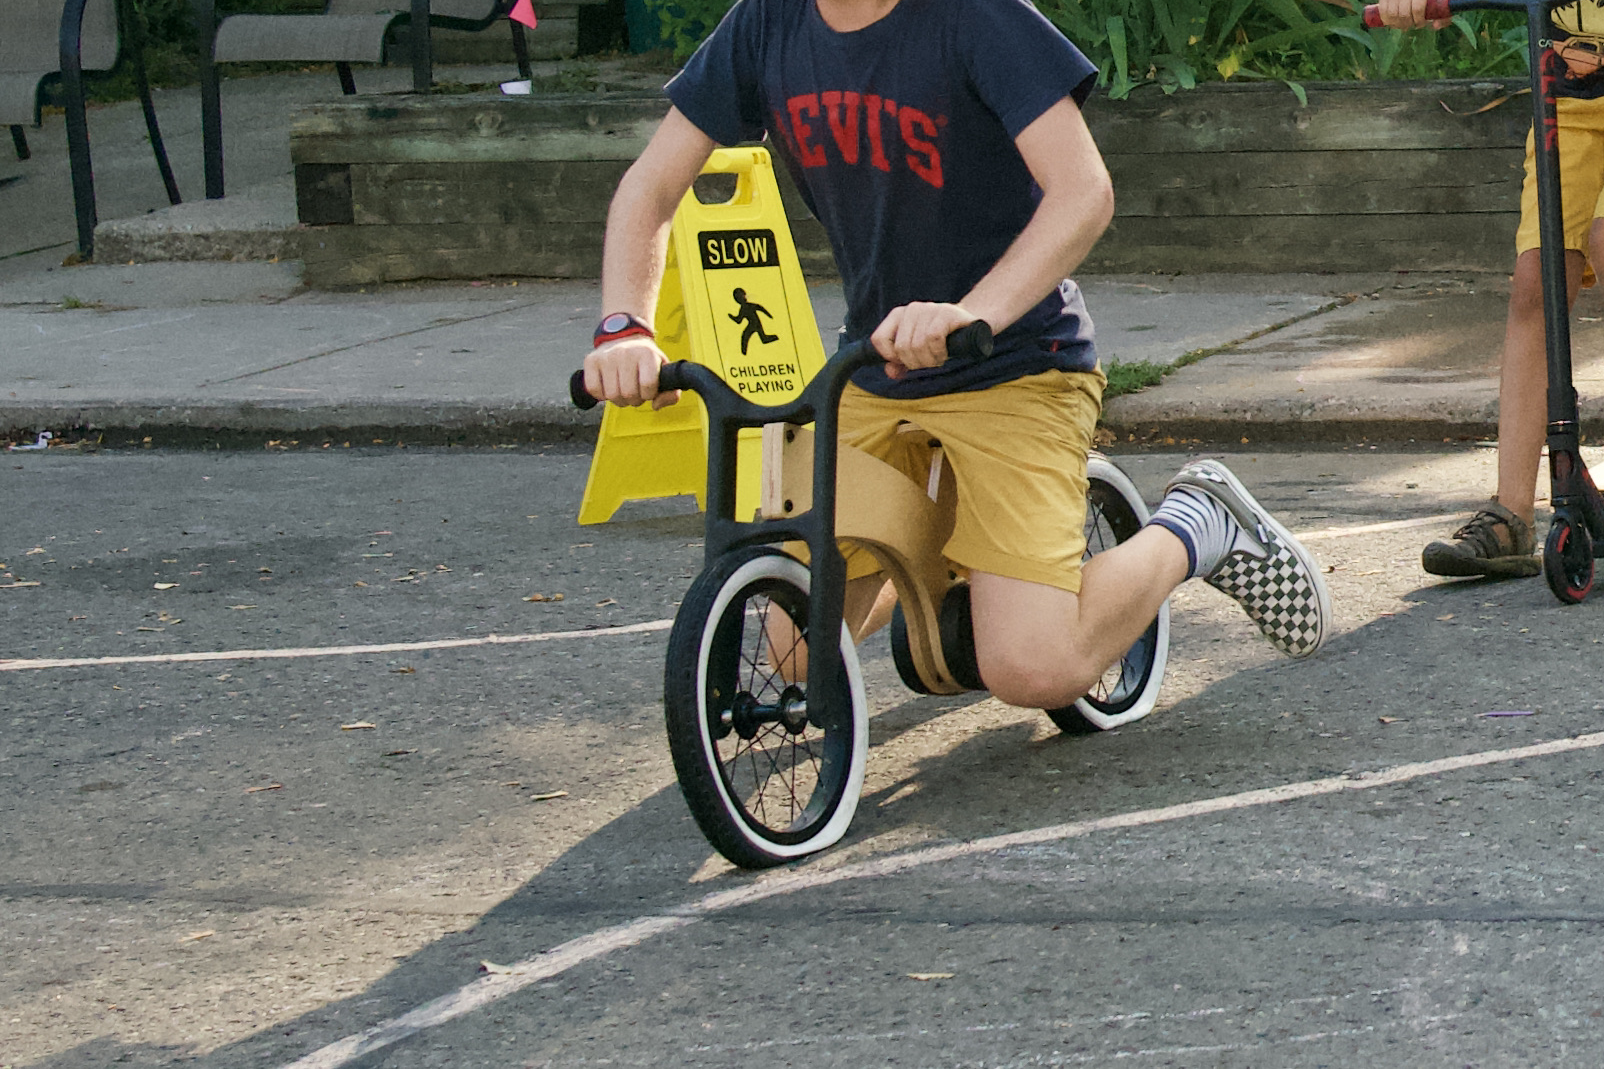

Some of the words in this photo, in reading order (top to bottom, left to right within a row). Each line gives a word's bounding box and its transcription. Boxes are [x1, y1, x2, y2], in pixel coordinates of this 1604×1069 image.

[707, 237, 767, 265] SLOW
[730, 363, 796, 378] CHILDREN
[738, 379, 794, 394] PLAYING
